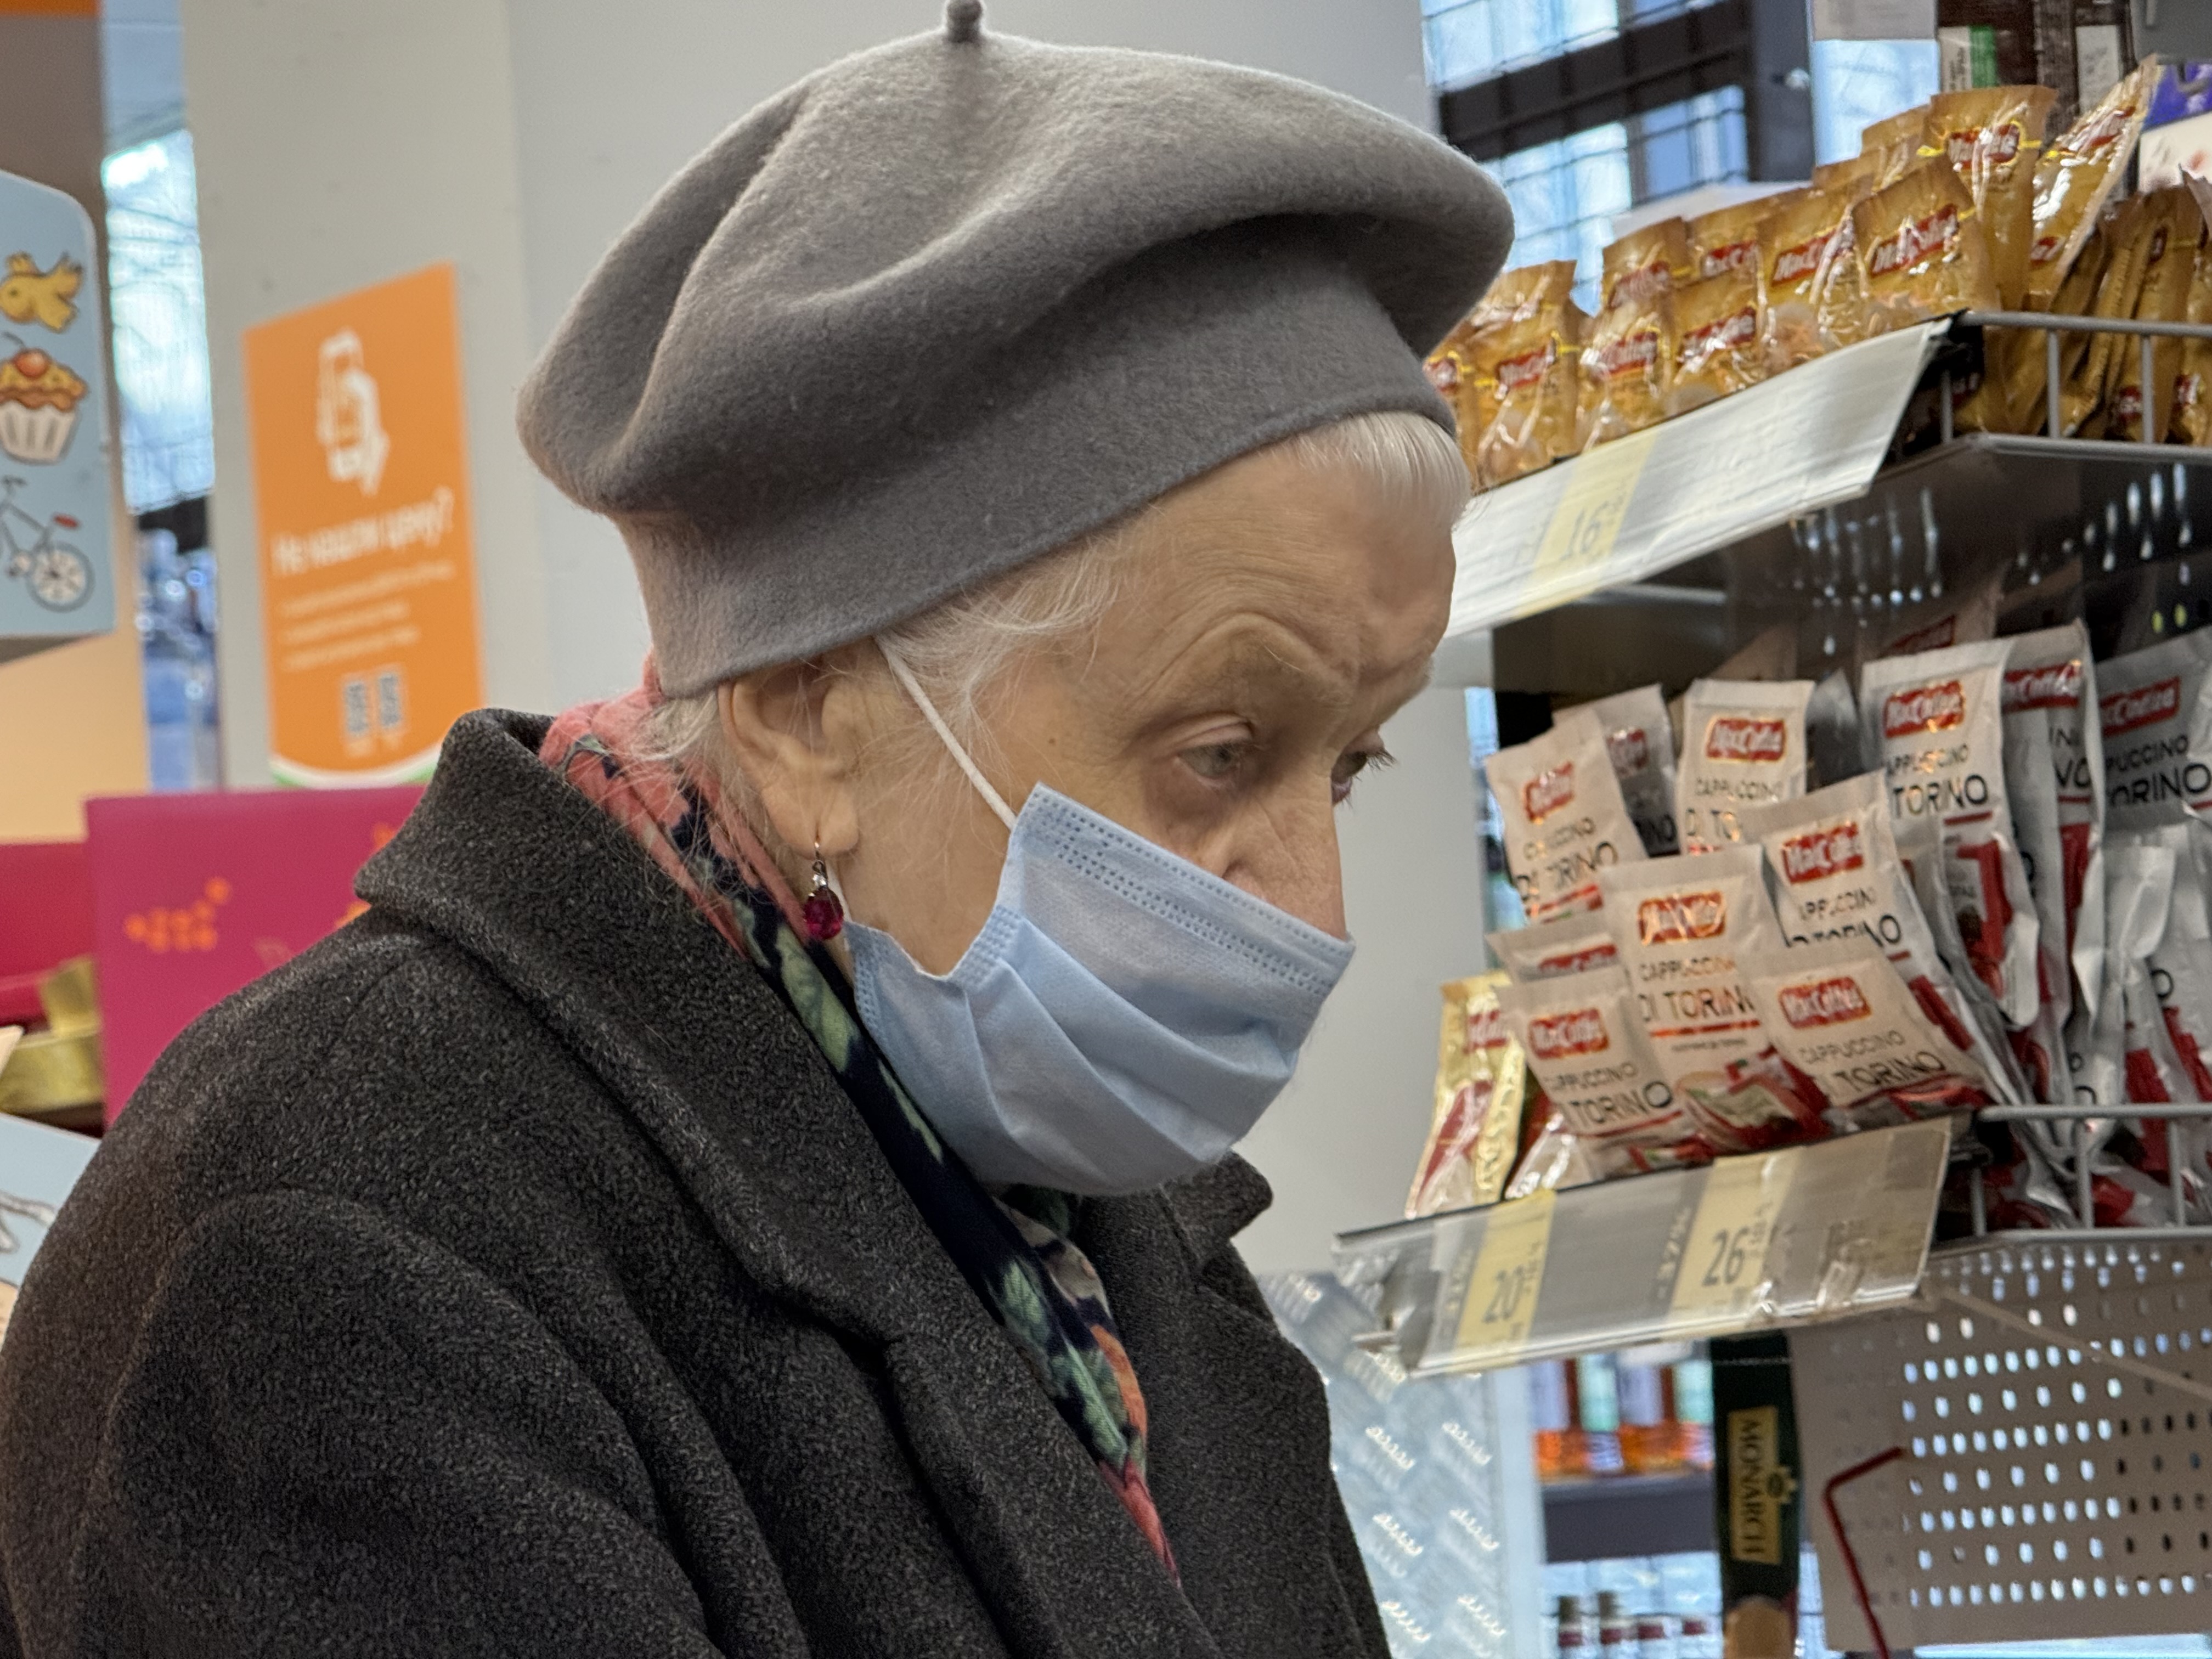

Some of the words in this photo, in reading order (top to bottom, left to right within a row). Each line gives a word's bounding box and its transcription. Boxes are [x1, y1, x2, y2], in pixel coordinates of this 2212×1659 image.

[2111, 761, 2212, 806] ORINO
[1663, 985, 1755, 1020] TORIN
[1702, 1226, 1750, 1286] 26
[1739, 1420, 1766, 1554] MONARCH
